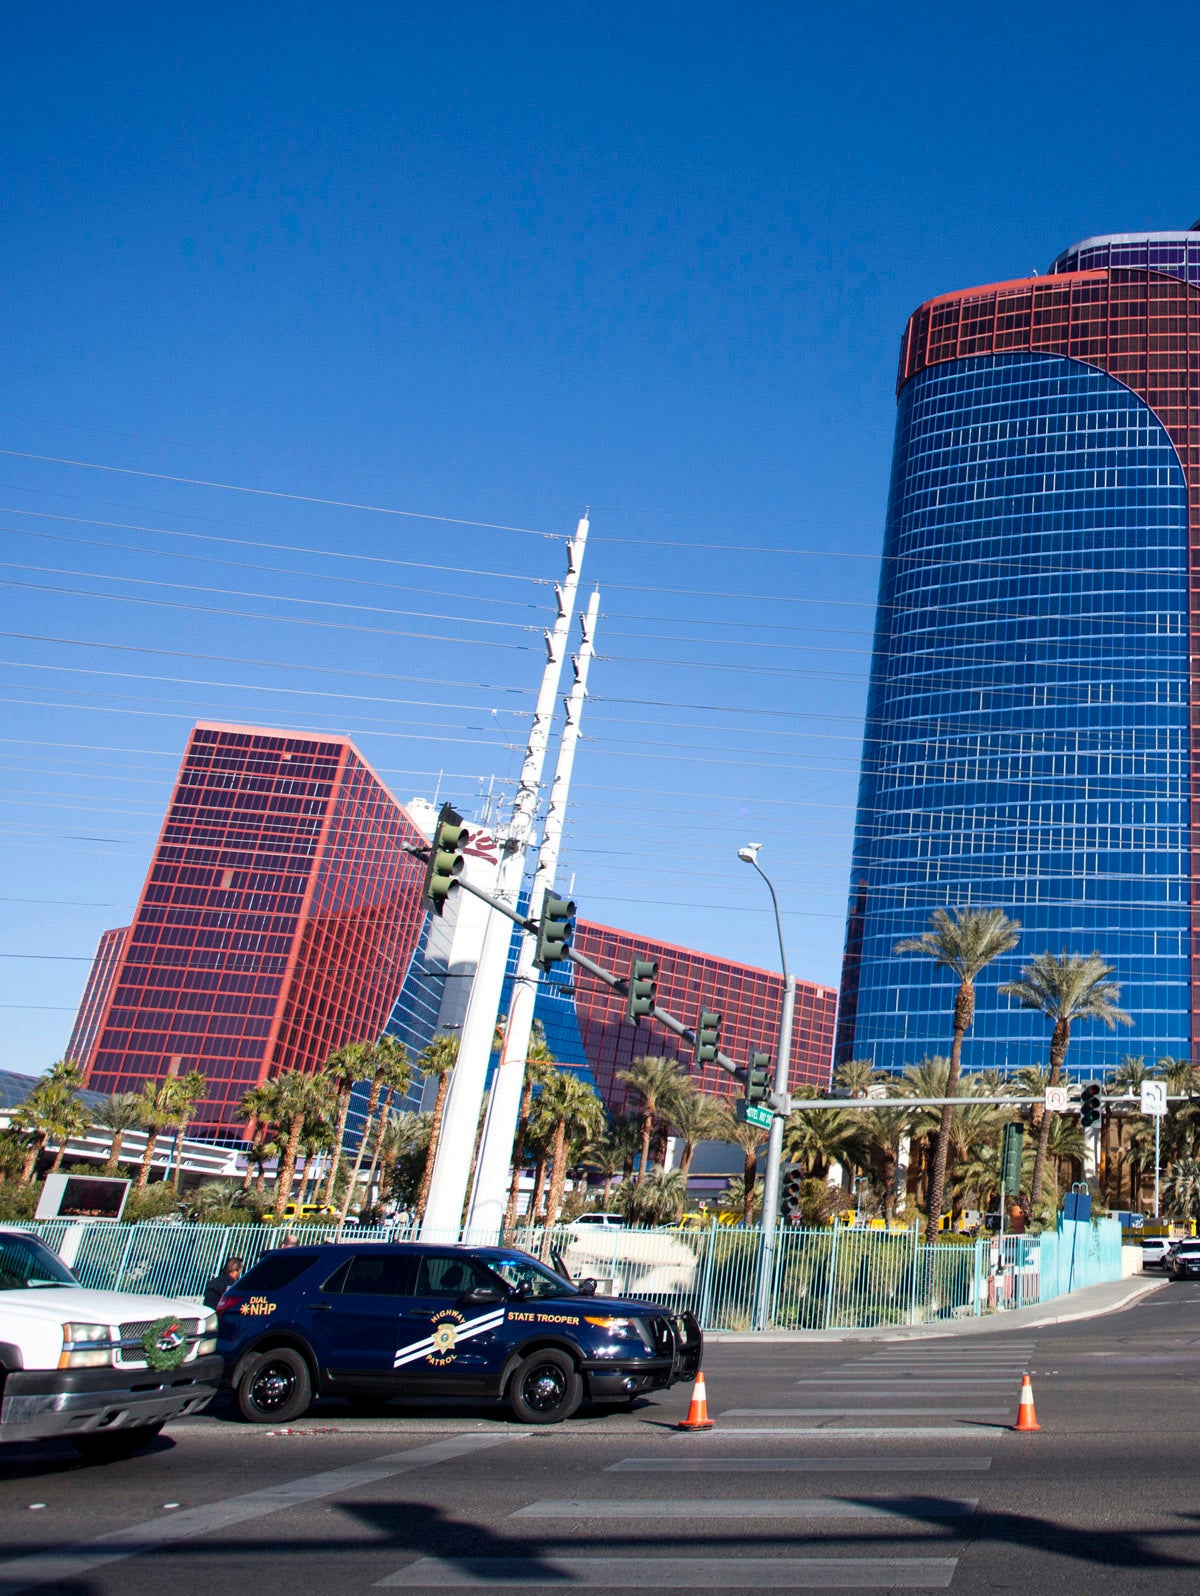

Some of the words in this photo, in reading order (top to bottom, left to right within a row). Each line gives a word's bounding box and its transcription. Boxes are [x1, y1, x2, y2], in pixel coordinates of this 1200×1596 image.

[250, 1296, 268, 1304] DIAL
[431, 1310, 465, 1323] HIGHWAY
[508, 1311, 534, 1322] STATE
[537, 1313, 579, 1325] TROOPER
[425, 1353, 457, 1367] PATROL
